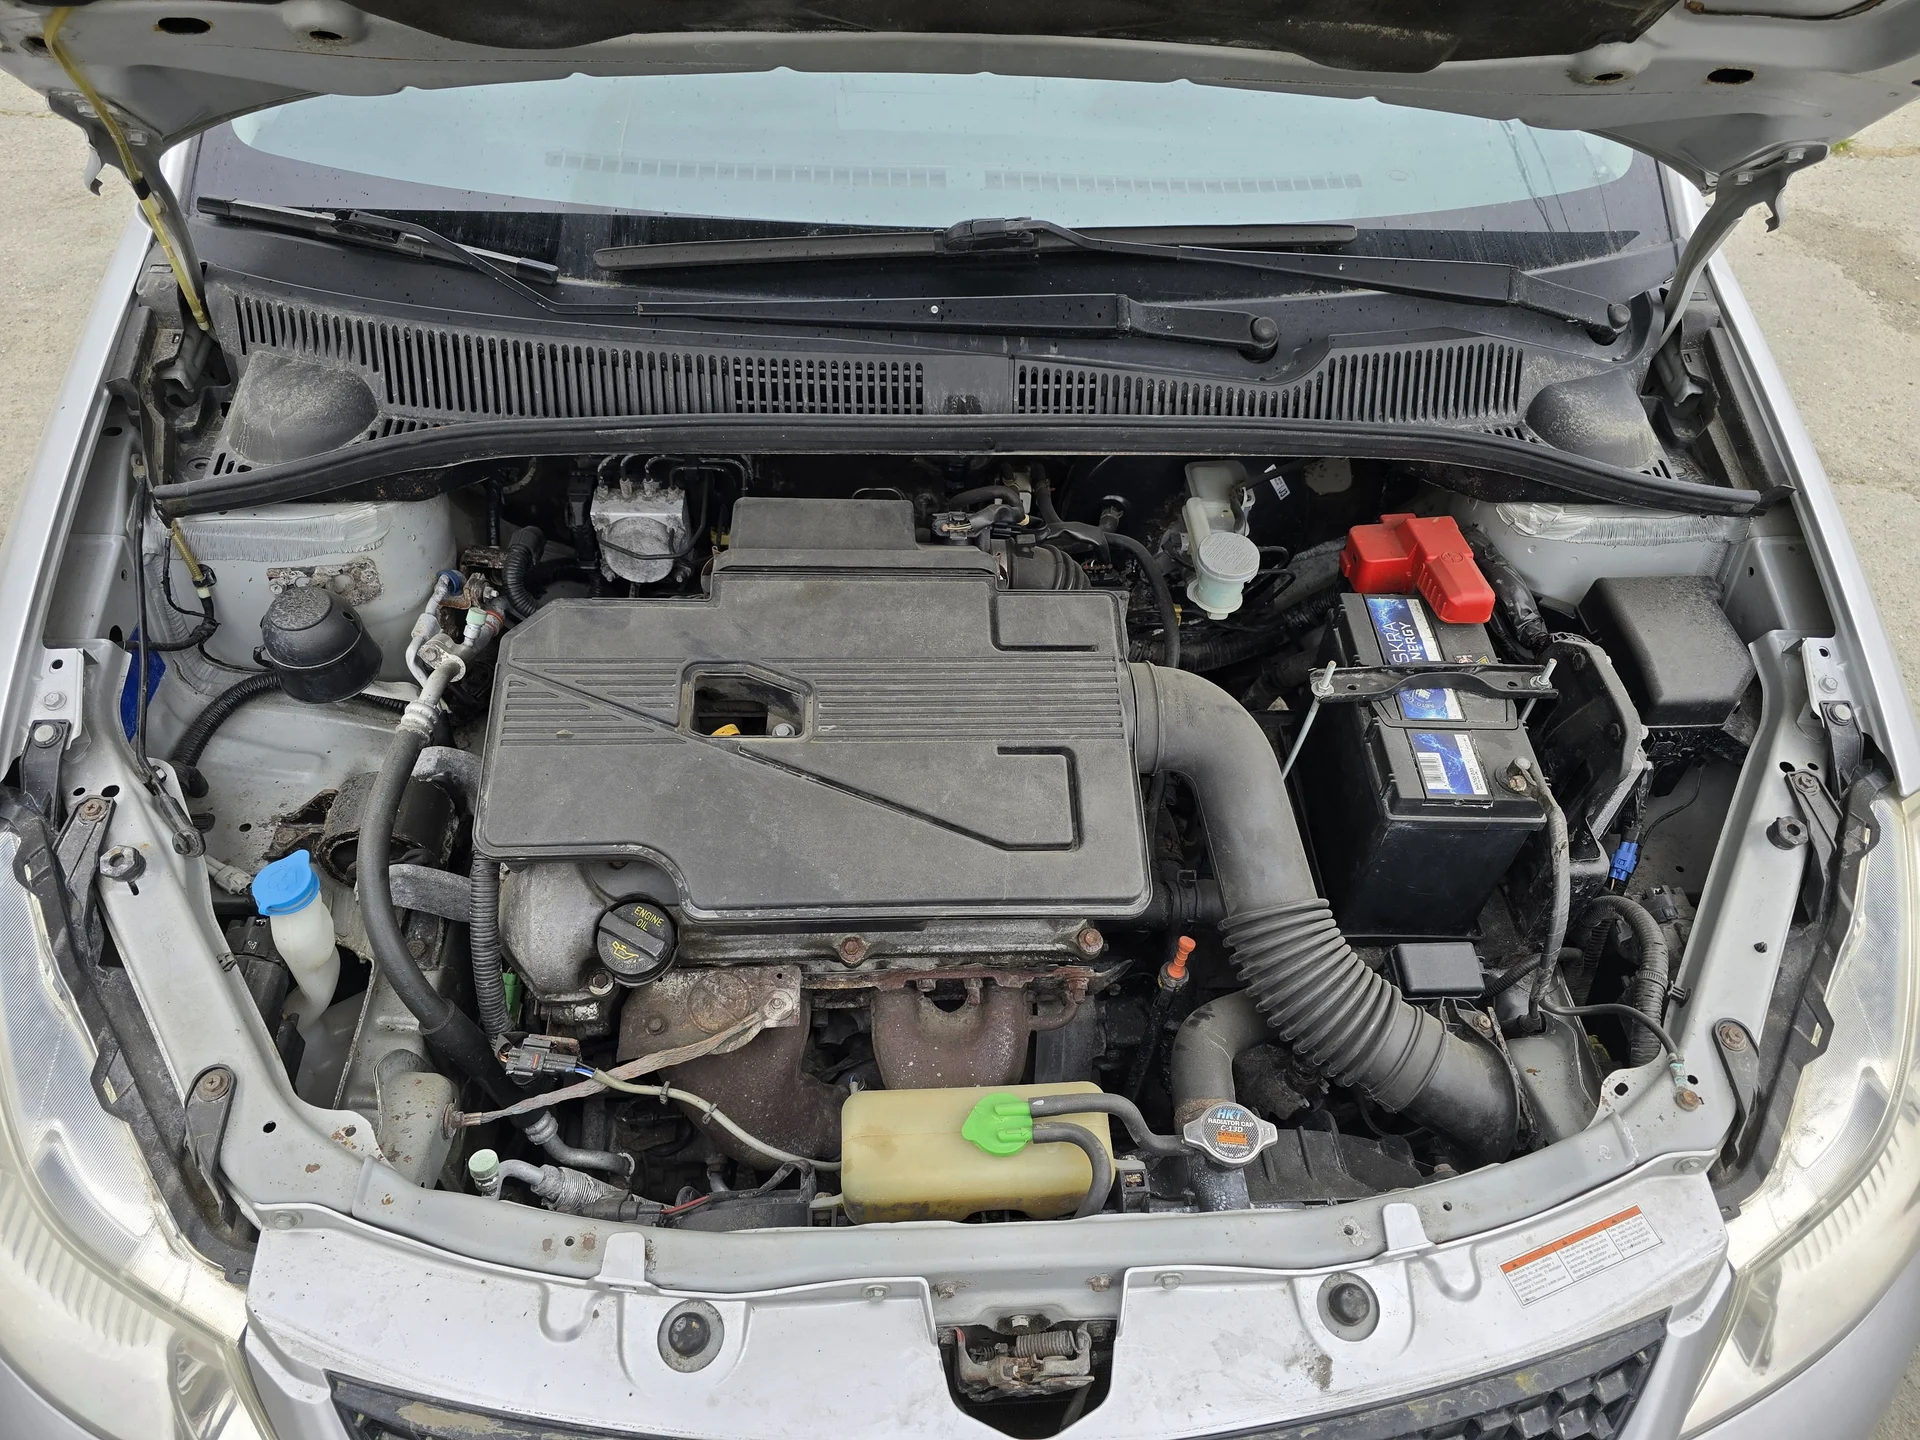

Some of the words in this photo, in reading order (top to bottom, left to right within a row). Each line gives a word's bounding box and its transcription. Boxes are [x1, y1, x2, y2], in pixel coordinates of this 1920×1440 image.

[1383, 622, 1409, 663] SKRA
[634, 906, 664, 927] ENGINE
[636, 919, 649, 931] OIL
[1217, 1108, 1244, 1121] HKT
[1208, 1118, 1240, 1127] RADIATOR
